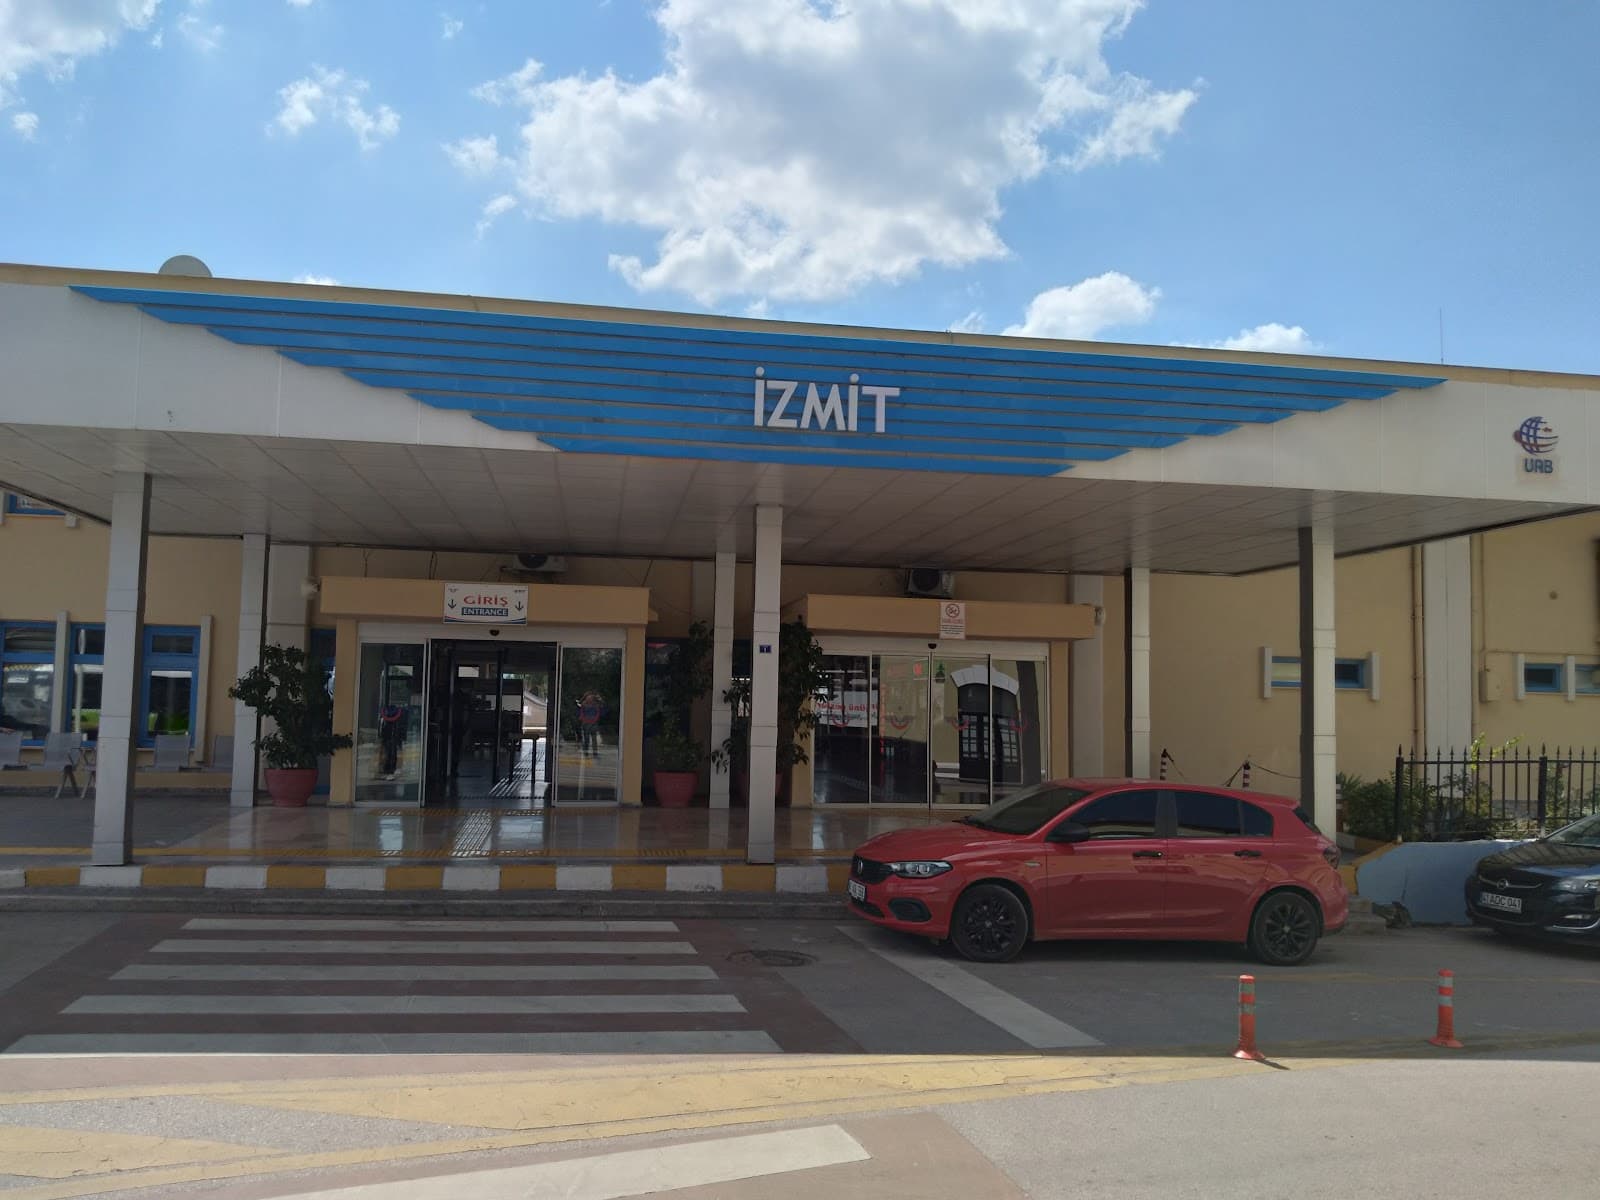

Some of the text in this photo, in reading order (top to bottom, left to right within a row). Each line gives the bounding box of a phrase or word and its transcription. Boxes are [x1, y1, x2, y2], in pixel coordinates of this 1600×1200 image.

[754, 366, 900, 433] İZMİT
[1524, 458, 1553, 473] UAB
[463, 608, 507, 616] ENTRANCE
